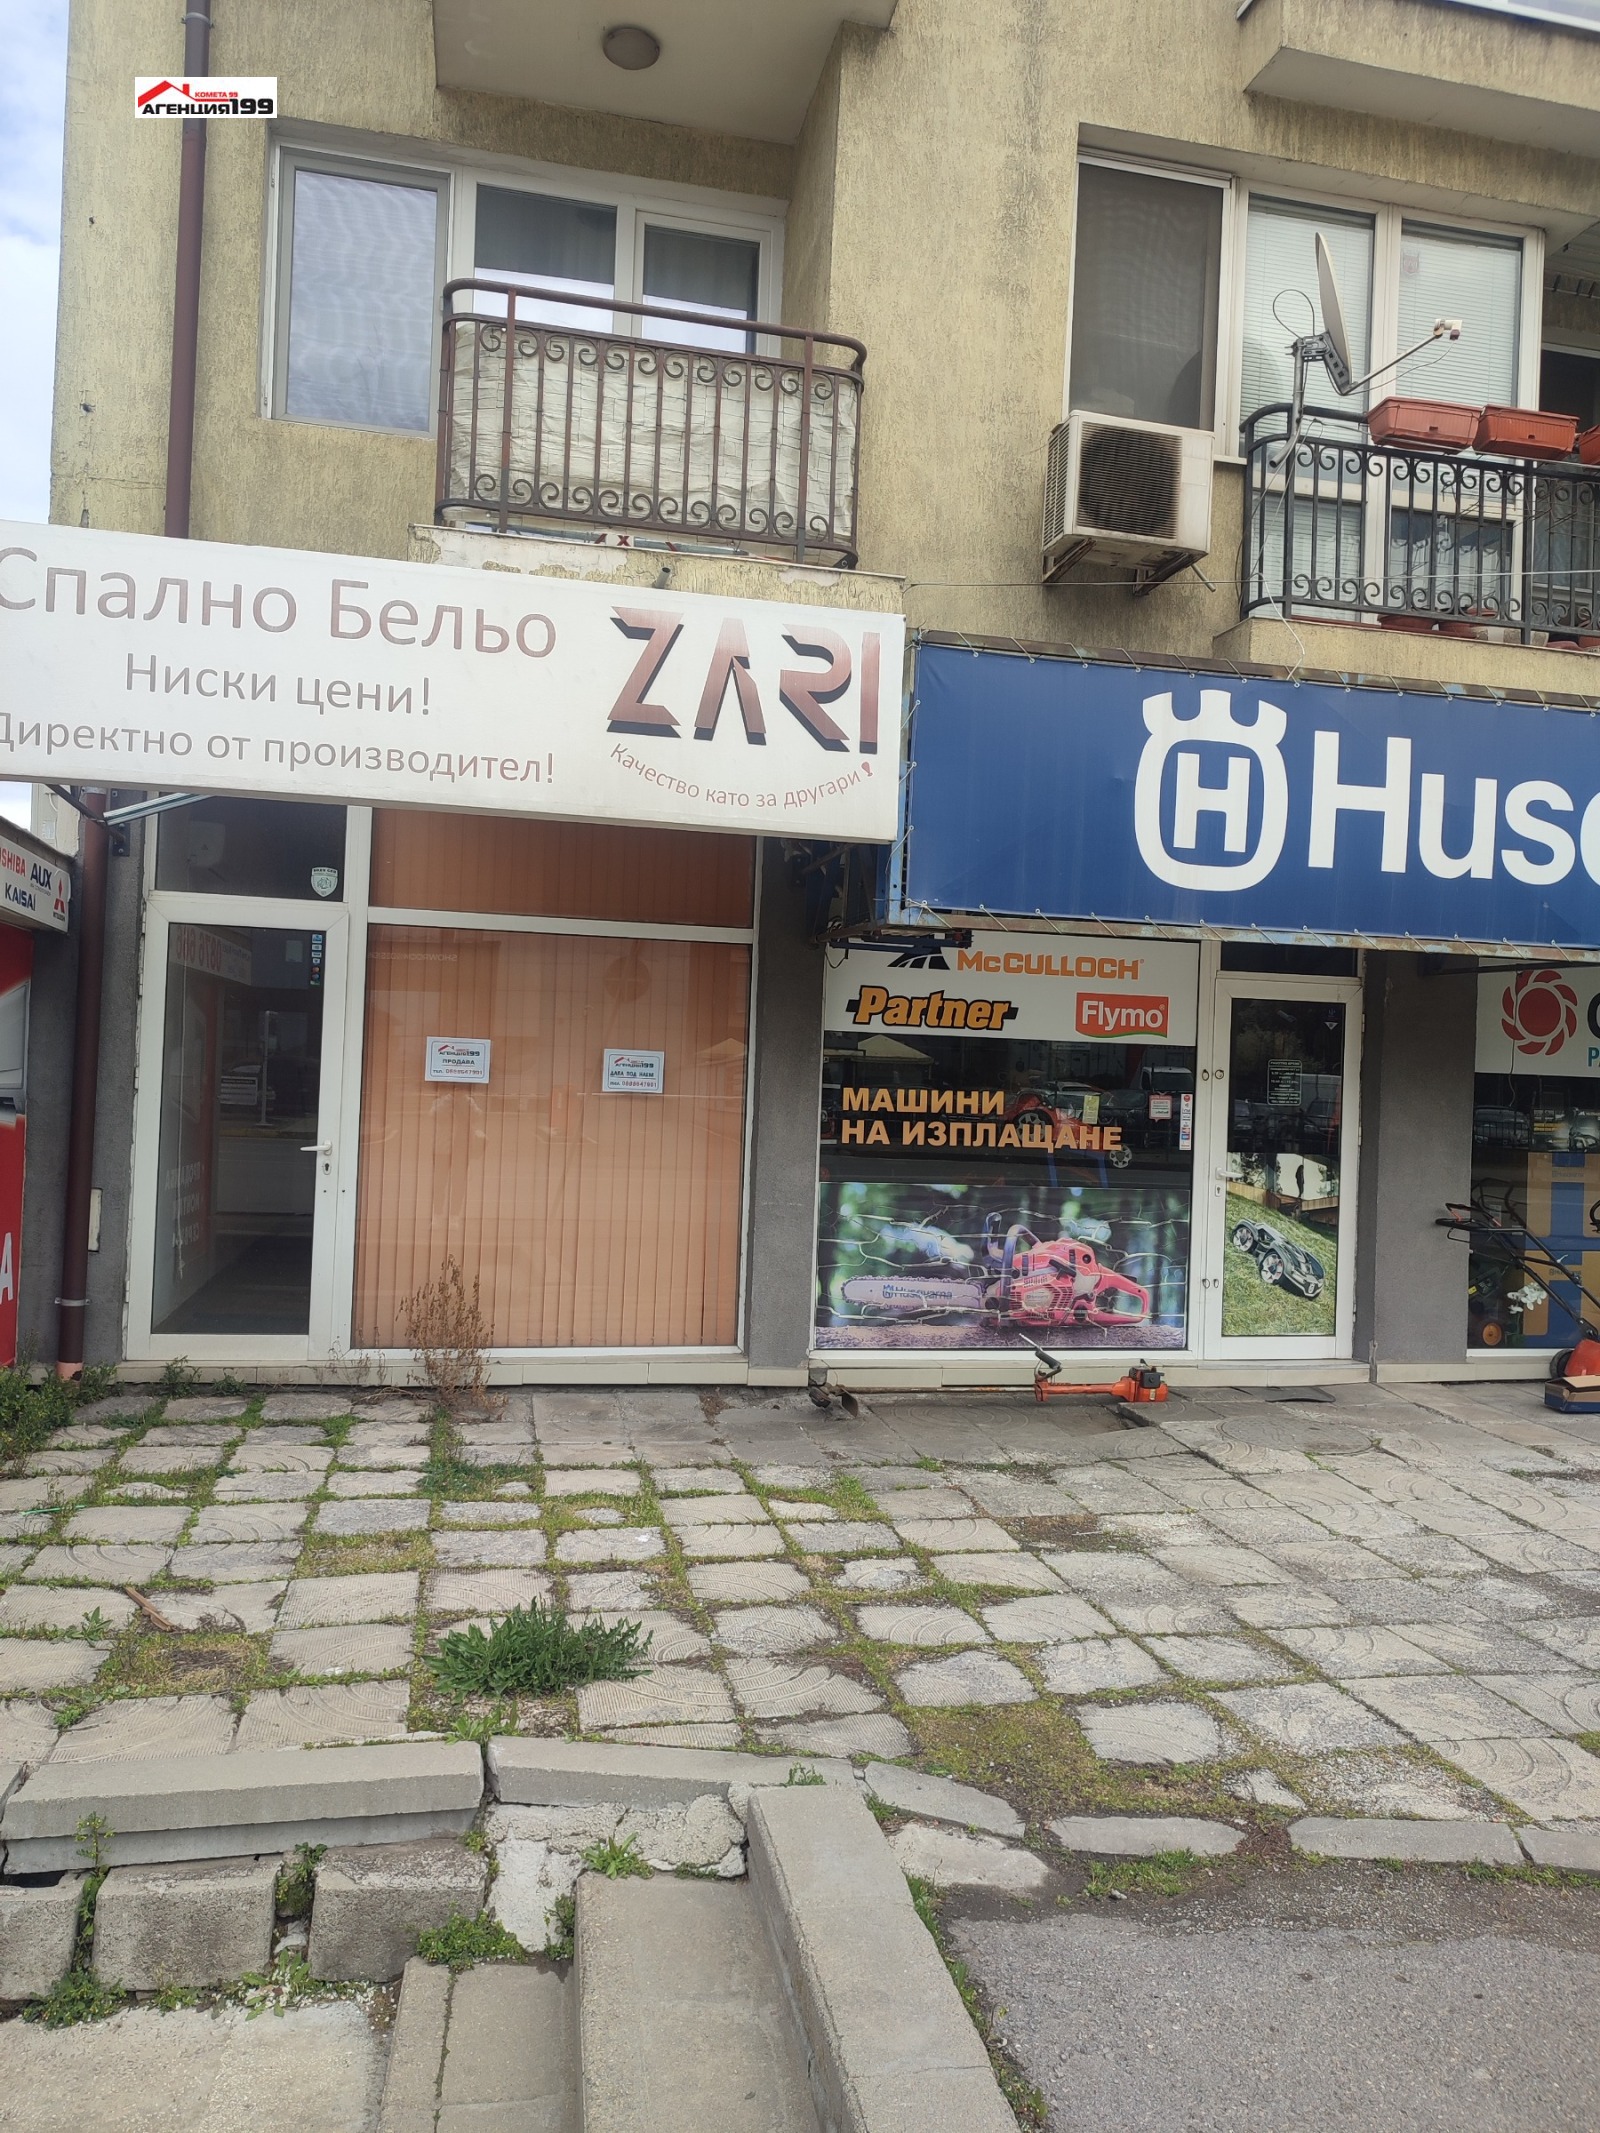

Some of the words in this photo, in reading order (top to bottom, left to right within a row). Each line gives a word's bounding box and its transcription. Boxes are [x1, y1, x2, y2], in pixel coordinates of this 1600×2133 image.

[0, 546, 297, 633] Спално
[330, 578, 557, 658] Бельо
[126, 652, 277, 702] Ниски
[296, 677, 430, 716] цени!
[606, 605, 881, 755] ZARI
[207, 734, 251, 761] от
[264, 738, 554, 784] производител!
[610, 742, 700, 799] Качество
[705, 787, 751, 808] като
[755, 791, 778, 808] за
[782, 760, 874, 810] другари!
[0, 847, 26, 878] SHIBA
[30, 862, 52, 891] AUX
[956, 950, 1140, 980] McCULLOCH
[852, 985, 1012, 1031] Partner
[1081, 1000, 1164, 1032] Flymo
[841, 1087, 1005, 1116] МАШИНИ
[841, 1119, 891, 1146] НА
[901, 1120, 1123, 1154] ИЗПЛАЩАНЕ
